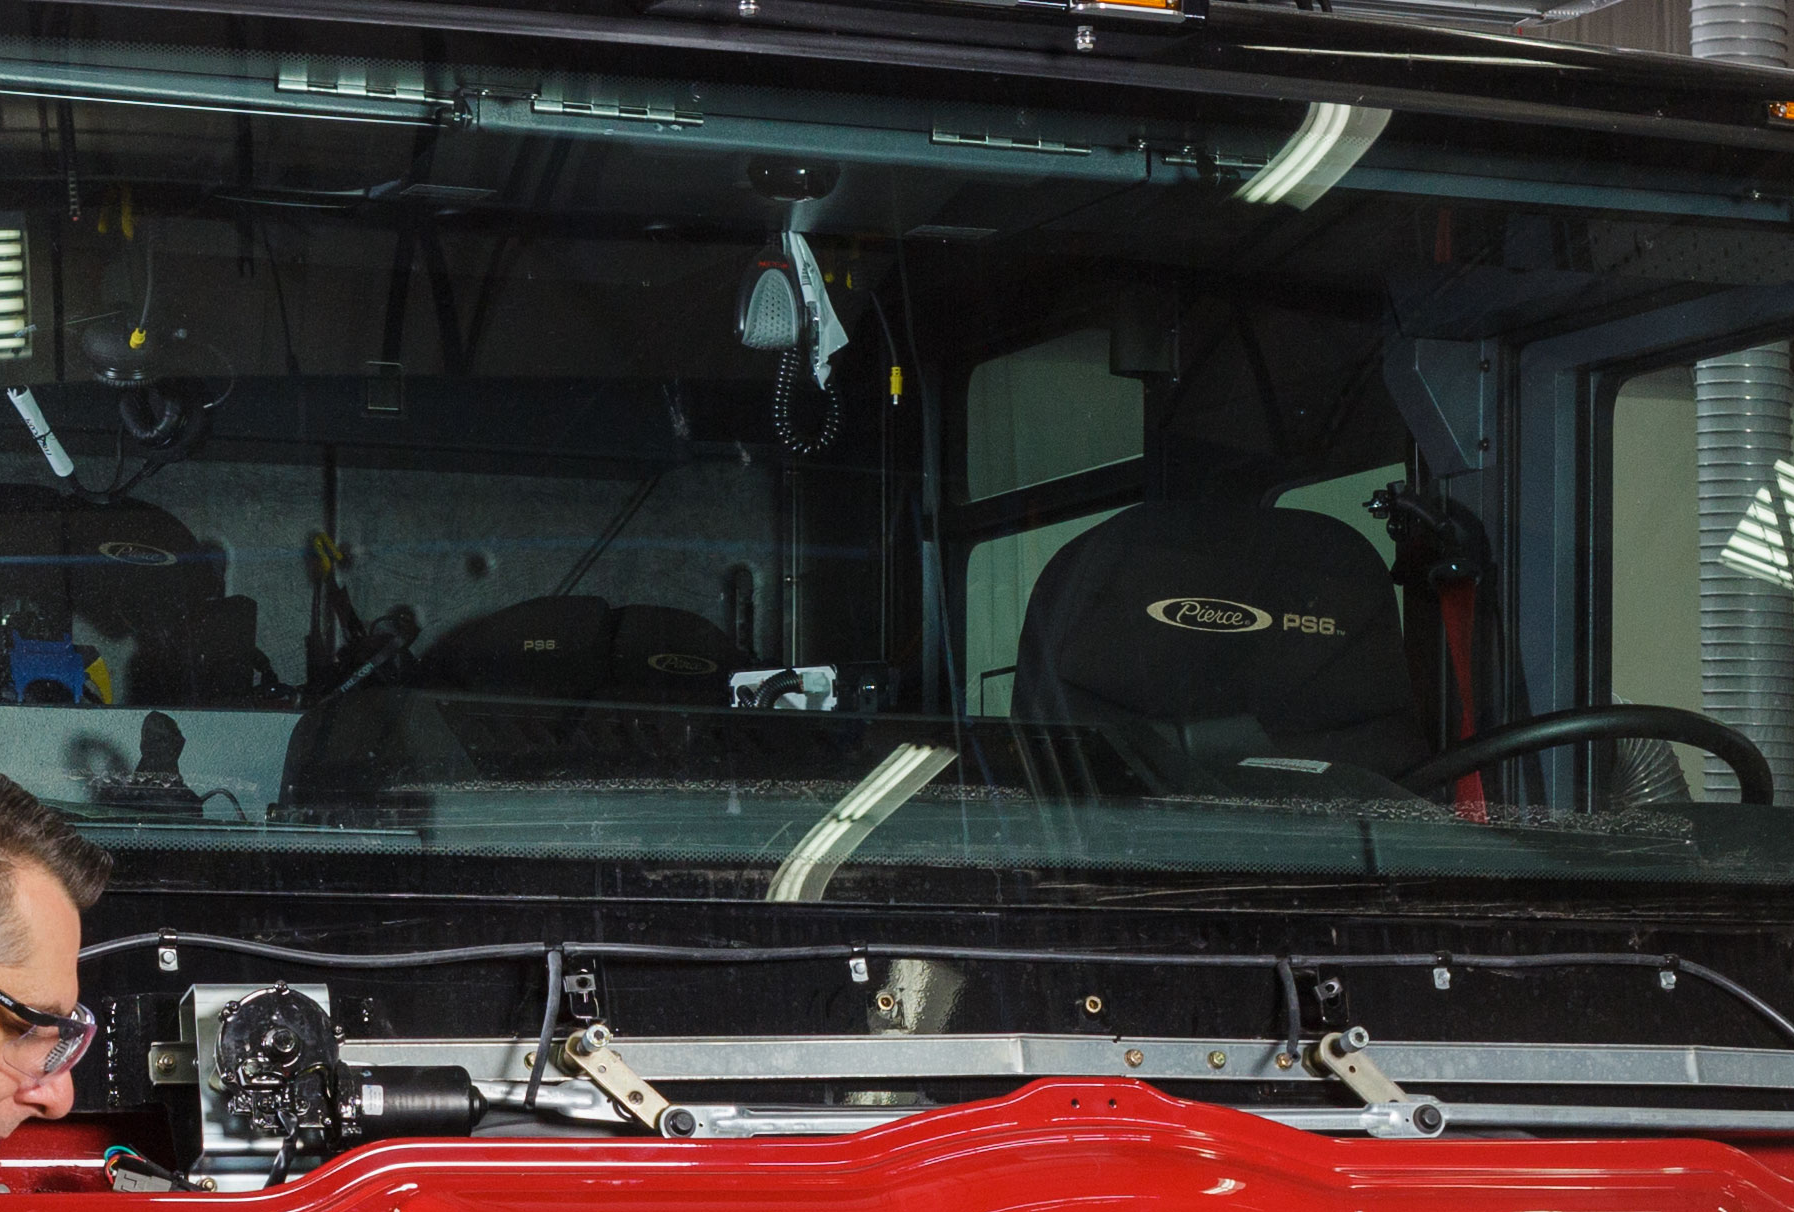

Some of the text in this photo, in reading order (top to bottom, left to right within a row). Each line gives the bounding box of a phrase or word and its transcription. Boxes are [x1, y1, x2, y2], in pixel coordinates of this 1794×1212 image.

[1176, 601, 1336, 635] Pierce PS6
[524, 640, 556, 651] PS6
